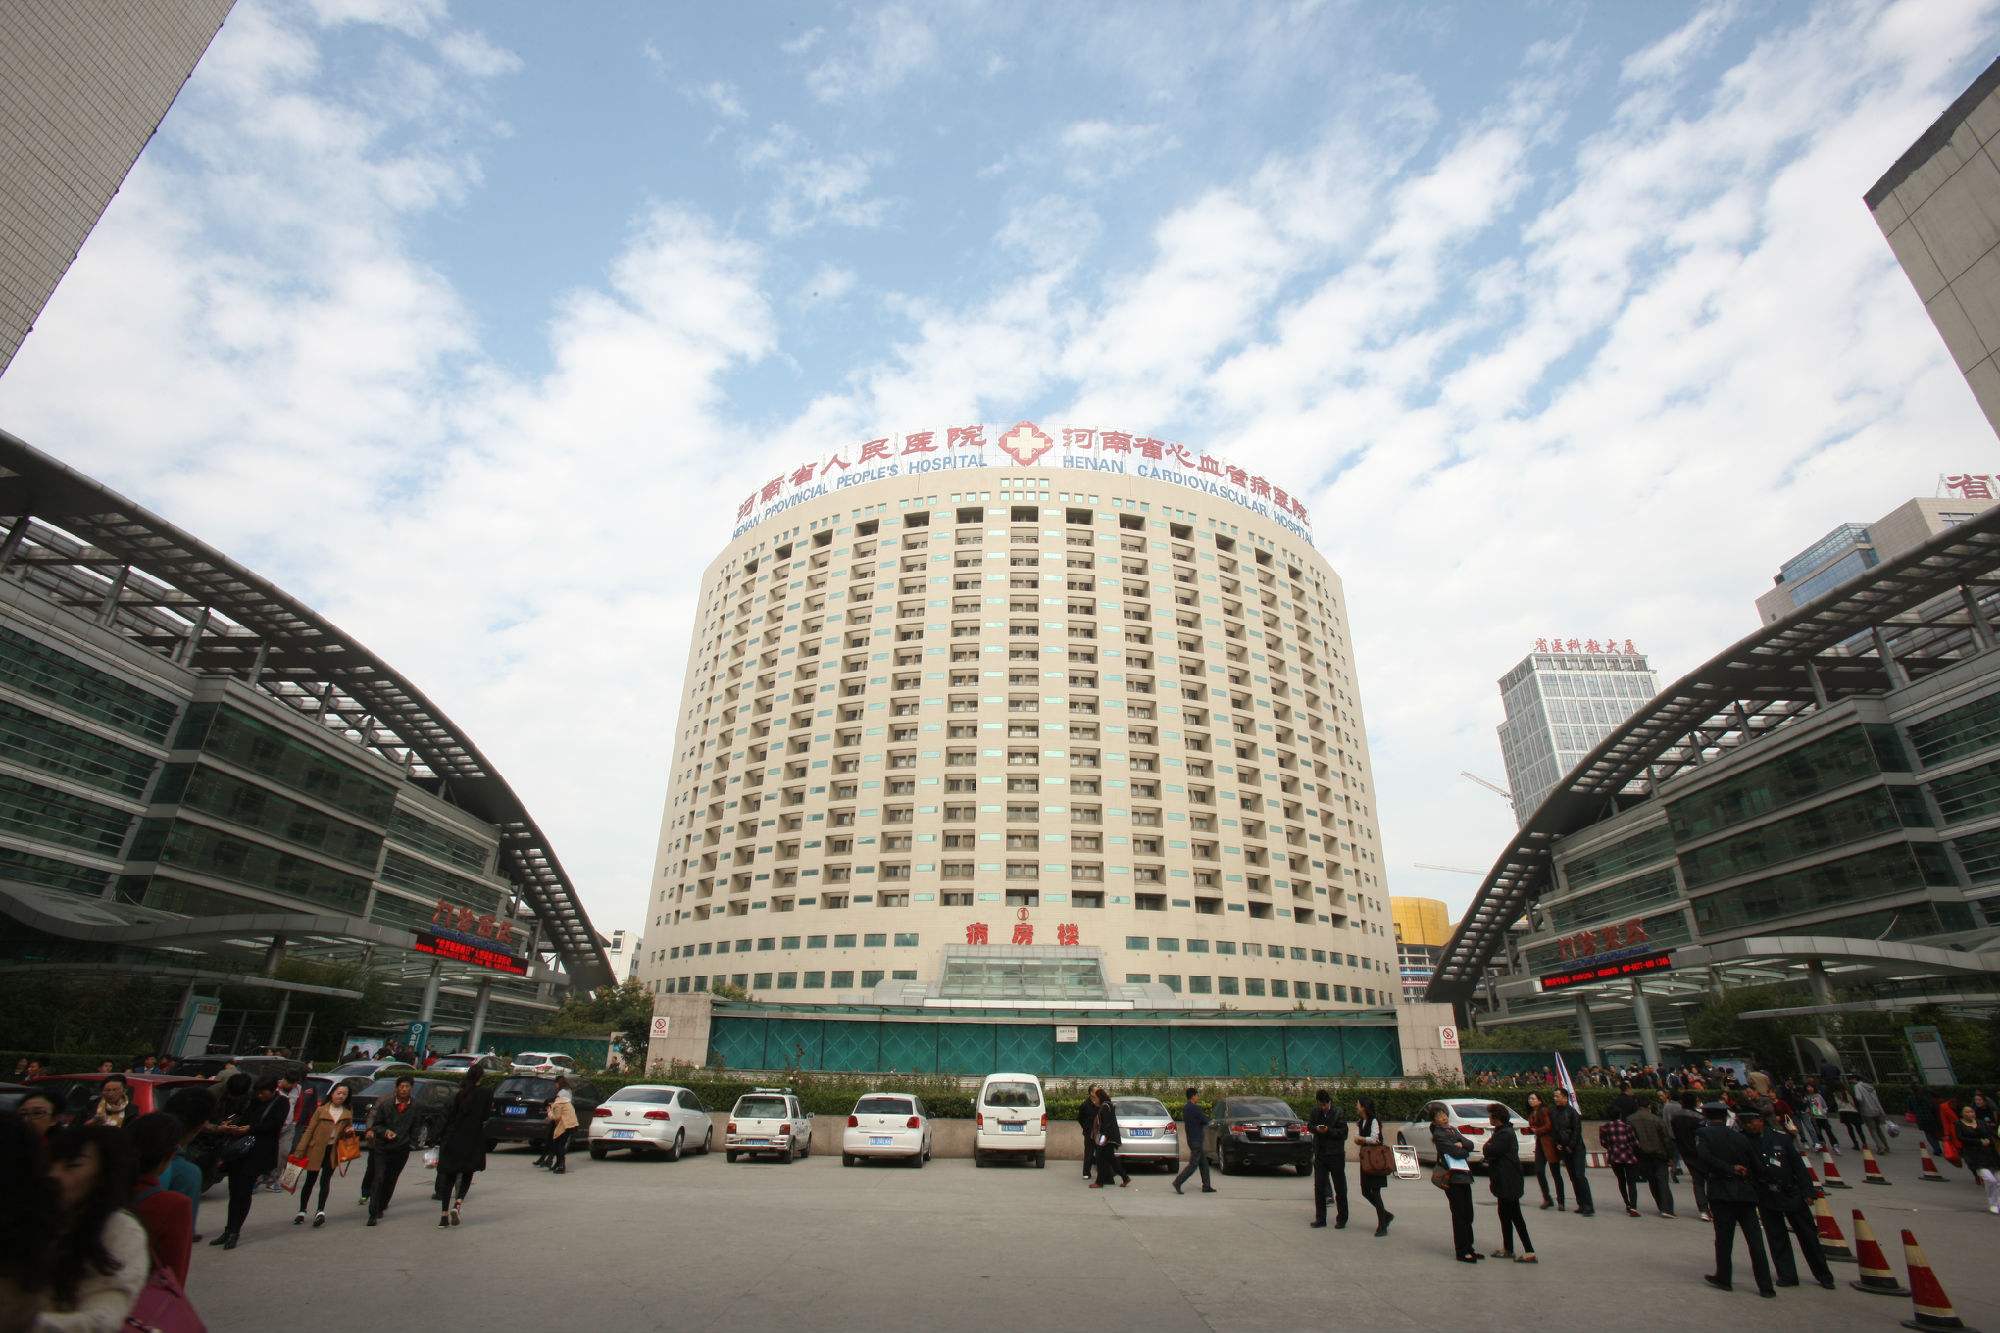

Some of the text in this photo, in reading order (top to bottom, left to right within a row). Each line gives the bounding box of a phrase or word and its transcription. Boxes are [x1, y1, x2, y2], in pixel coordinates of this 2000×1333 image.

[732, 454, 987, 541] HENAN PROVINCIAL PEOPLE'S HOSPITAL
[736, 425, 987, 523] 河南省人民医院
[1062, 428, 1310, 526] 河南省心血管病医院
[1063, 455, 1315, 548] HENAN CARDIOVASCULAR HOSPITAL
[1946, 473, 2000, 500] 省
[966, 922, 1079, 945] 病房楼
